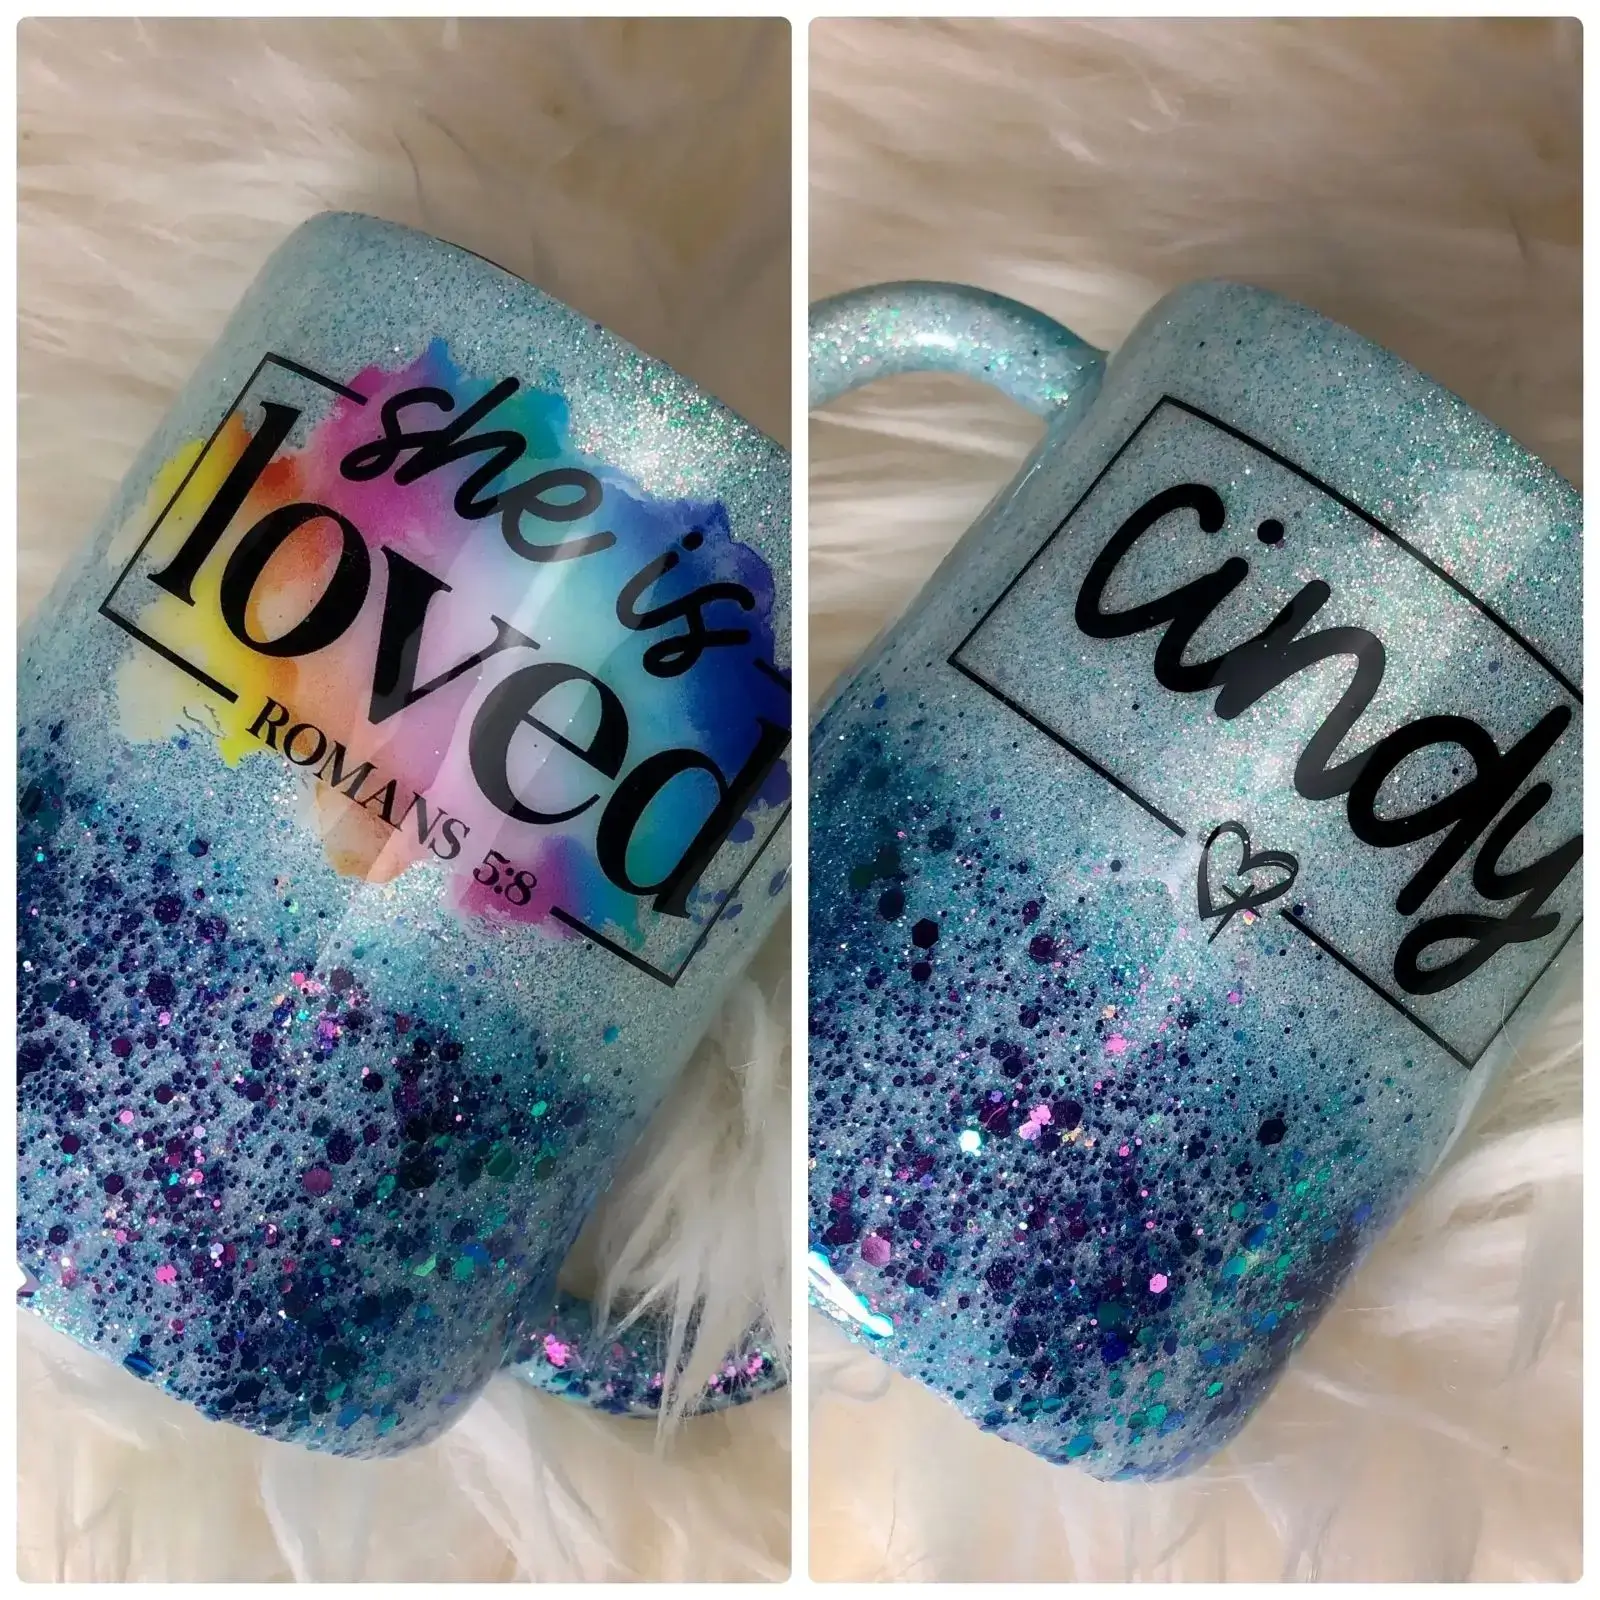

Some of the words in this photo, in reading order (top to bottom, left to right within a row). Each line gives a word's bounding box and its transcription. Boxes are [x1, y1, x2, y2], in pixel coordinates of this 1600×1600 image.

[146, 400, 791, 918] loved
[340, 376, 616, 563] she
[615, 531, 756, 679] is
[245, 697, 471, 860] ROMANS
[472, 849, 539, 907] 5:8
[1074, 482, 1583, 995] cindy
